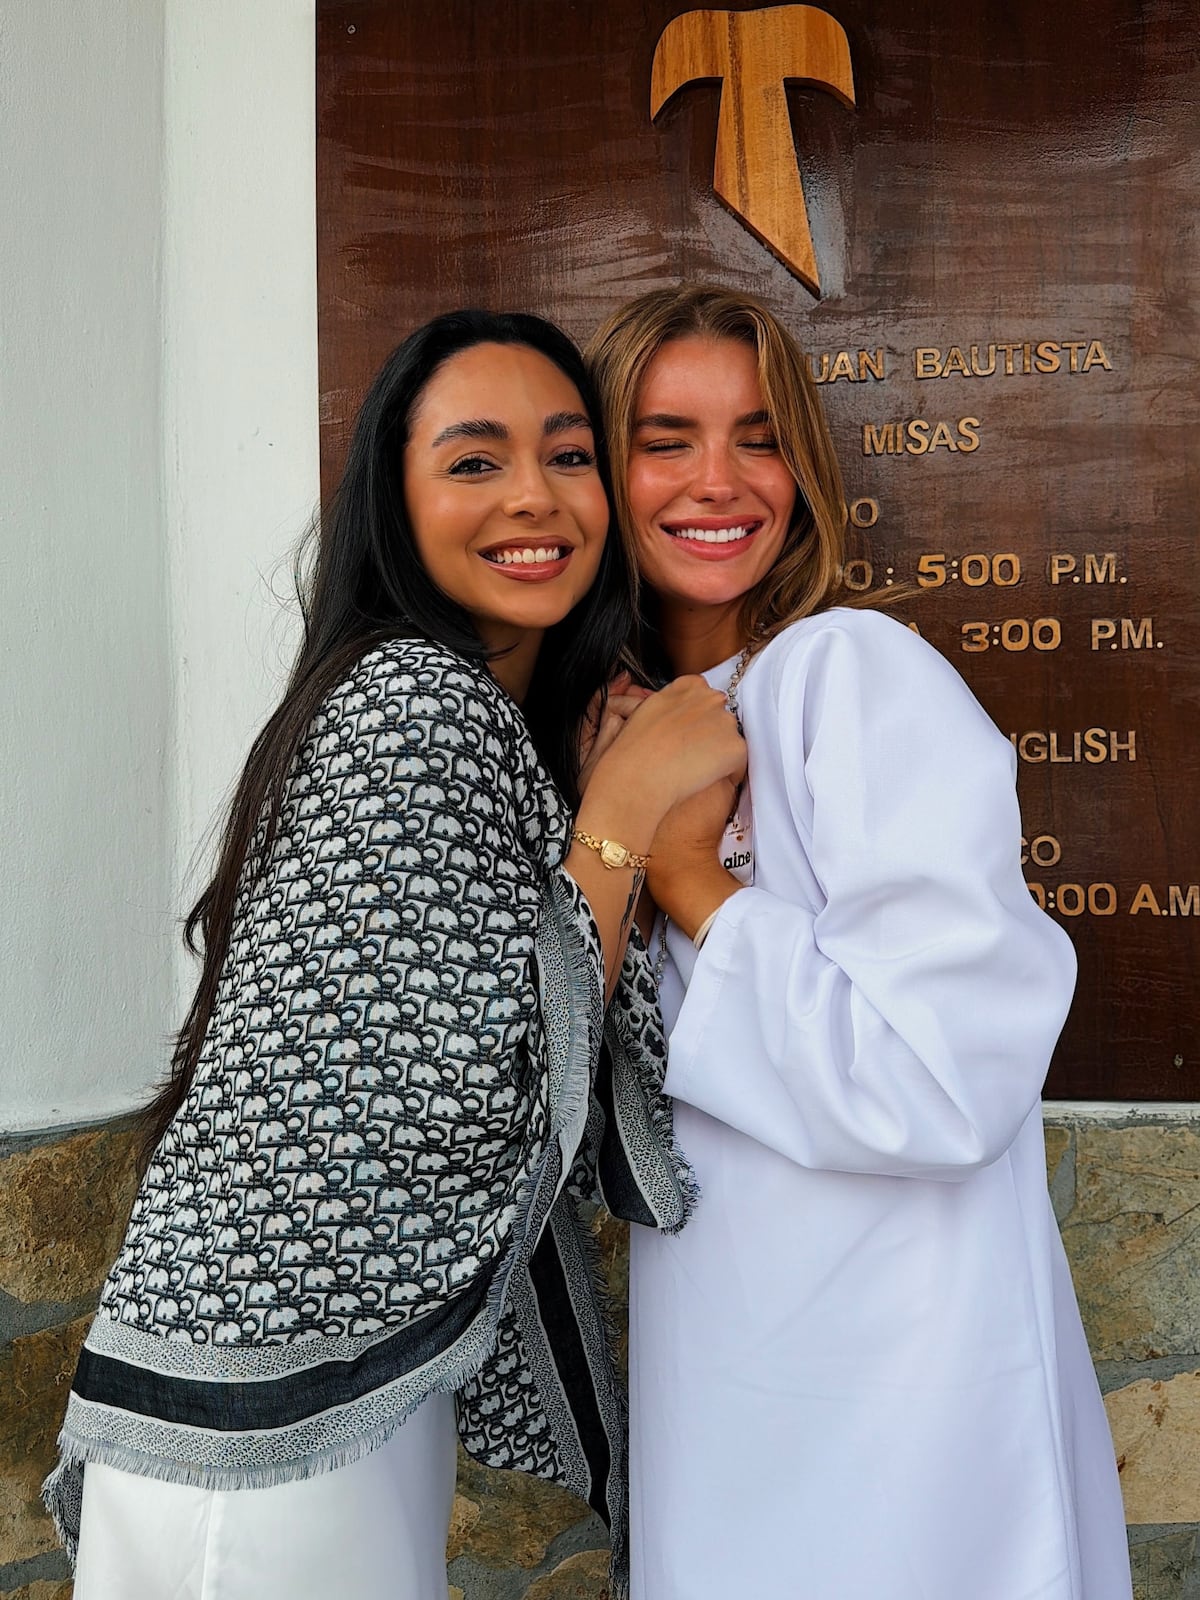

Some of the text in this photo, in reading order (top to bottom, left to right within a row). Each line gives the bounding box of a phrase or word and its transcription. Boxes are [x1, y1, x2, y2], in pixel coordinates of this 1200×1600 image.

[916, 341, 1113, 378] BAUTISTA
[863, 418, 980, 455] MISAS
[917, 553, 1021, 588] 5:00
[1051, 553, 1128, 585] P.M.
[961, 618, 1164, 652] 3:00 P.M.
